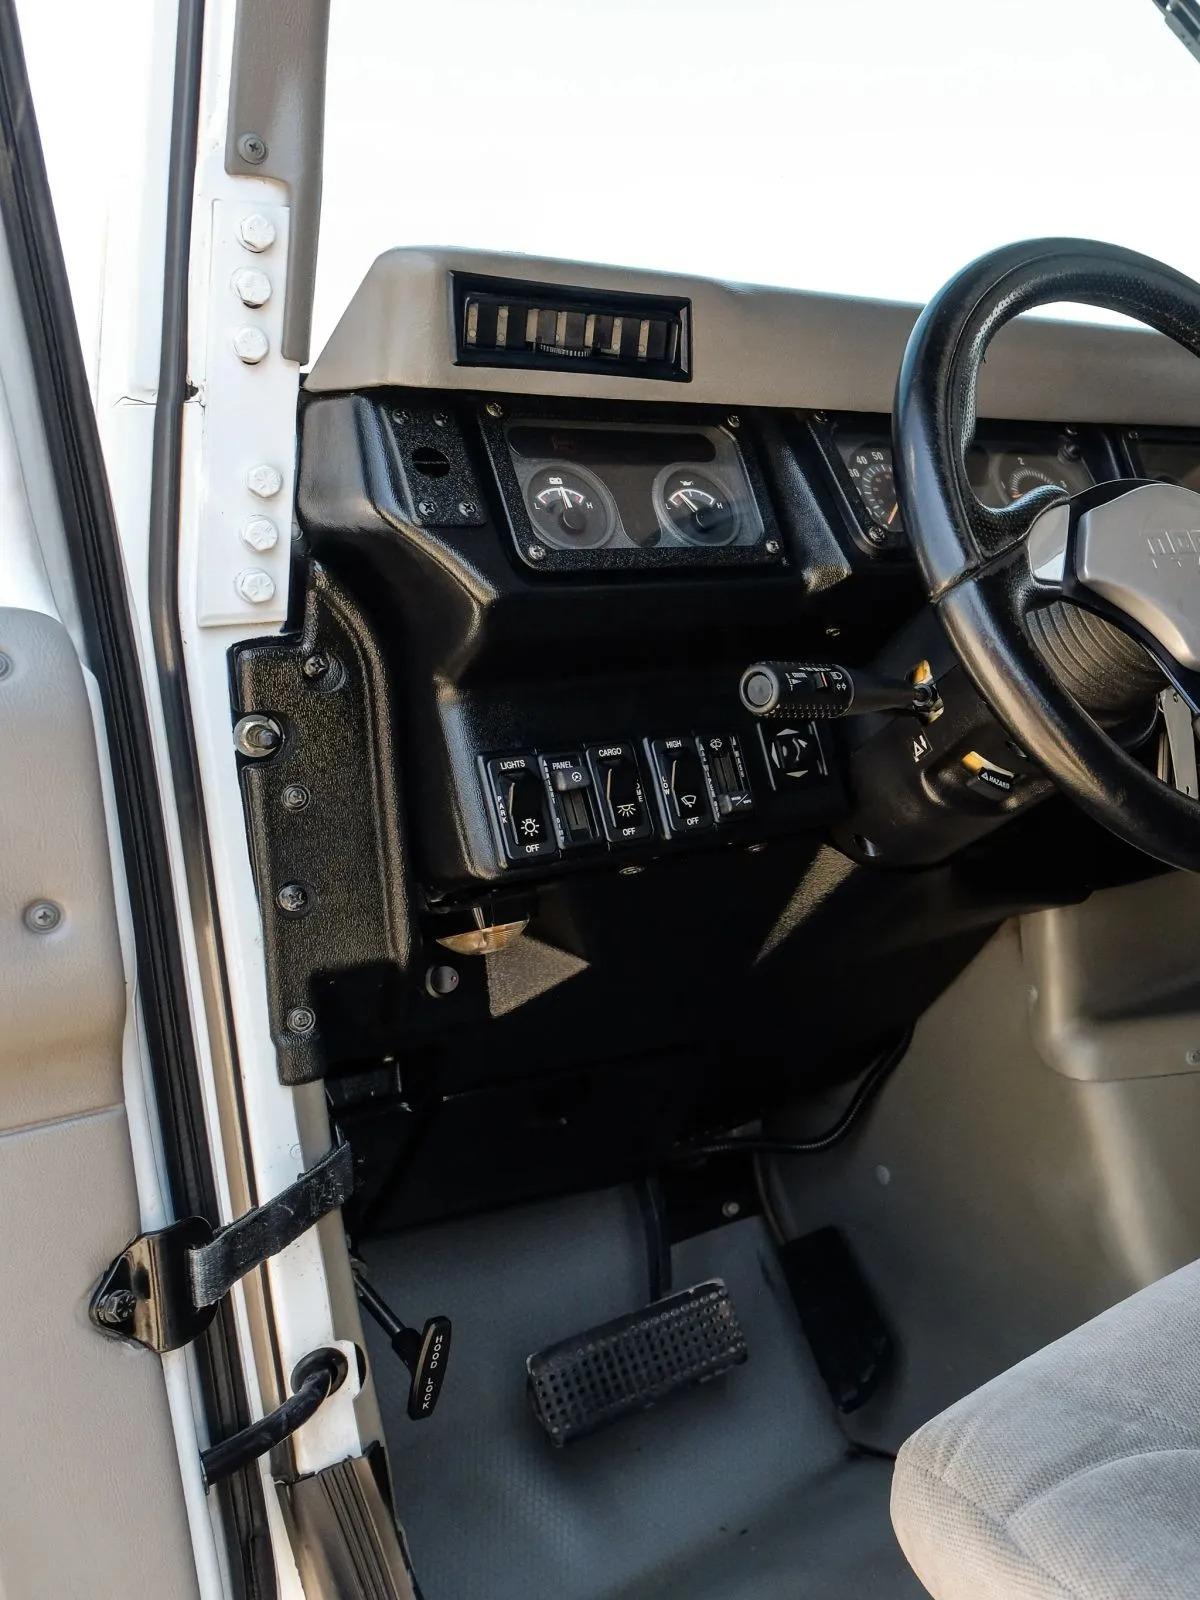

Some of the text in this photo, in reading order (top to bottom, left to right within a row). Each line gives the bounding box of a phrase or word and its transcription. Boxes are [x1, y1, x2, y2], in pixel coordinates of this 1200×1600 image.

[856, 455, 868, 465] 40
[871, 451, 884, 461] 50
[1017, 456, 1025, 466] 2
[848, 468, 860, 478] 30
[533, 502, 541, 511] L
[586, 502, 594, 510] H
[666, 503, 672, 511] L
[716, 502, 724, 510] H
[665, 739, 682, 749] HIGH
[598, 747, 622, 757] CARGO
[500, 759, 526, 770] LIGHTS
[552, 760, 574, 770] PANEL
[661, 775, 670, 795] LOW
[989, 775, 1010, 790] HAZARD
[497, 795, 508, 824] PARK
[686, 816, 700, 826] OFF
[622, 827, 636, 836] OFF
[525, 843, 540, 853] OFF
[422, 1335, 443, 1410] HOOD LOCK
